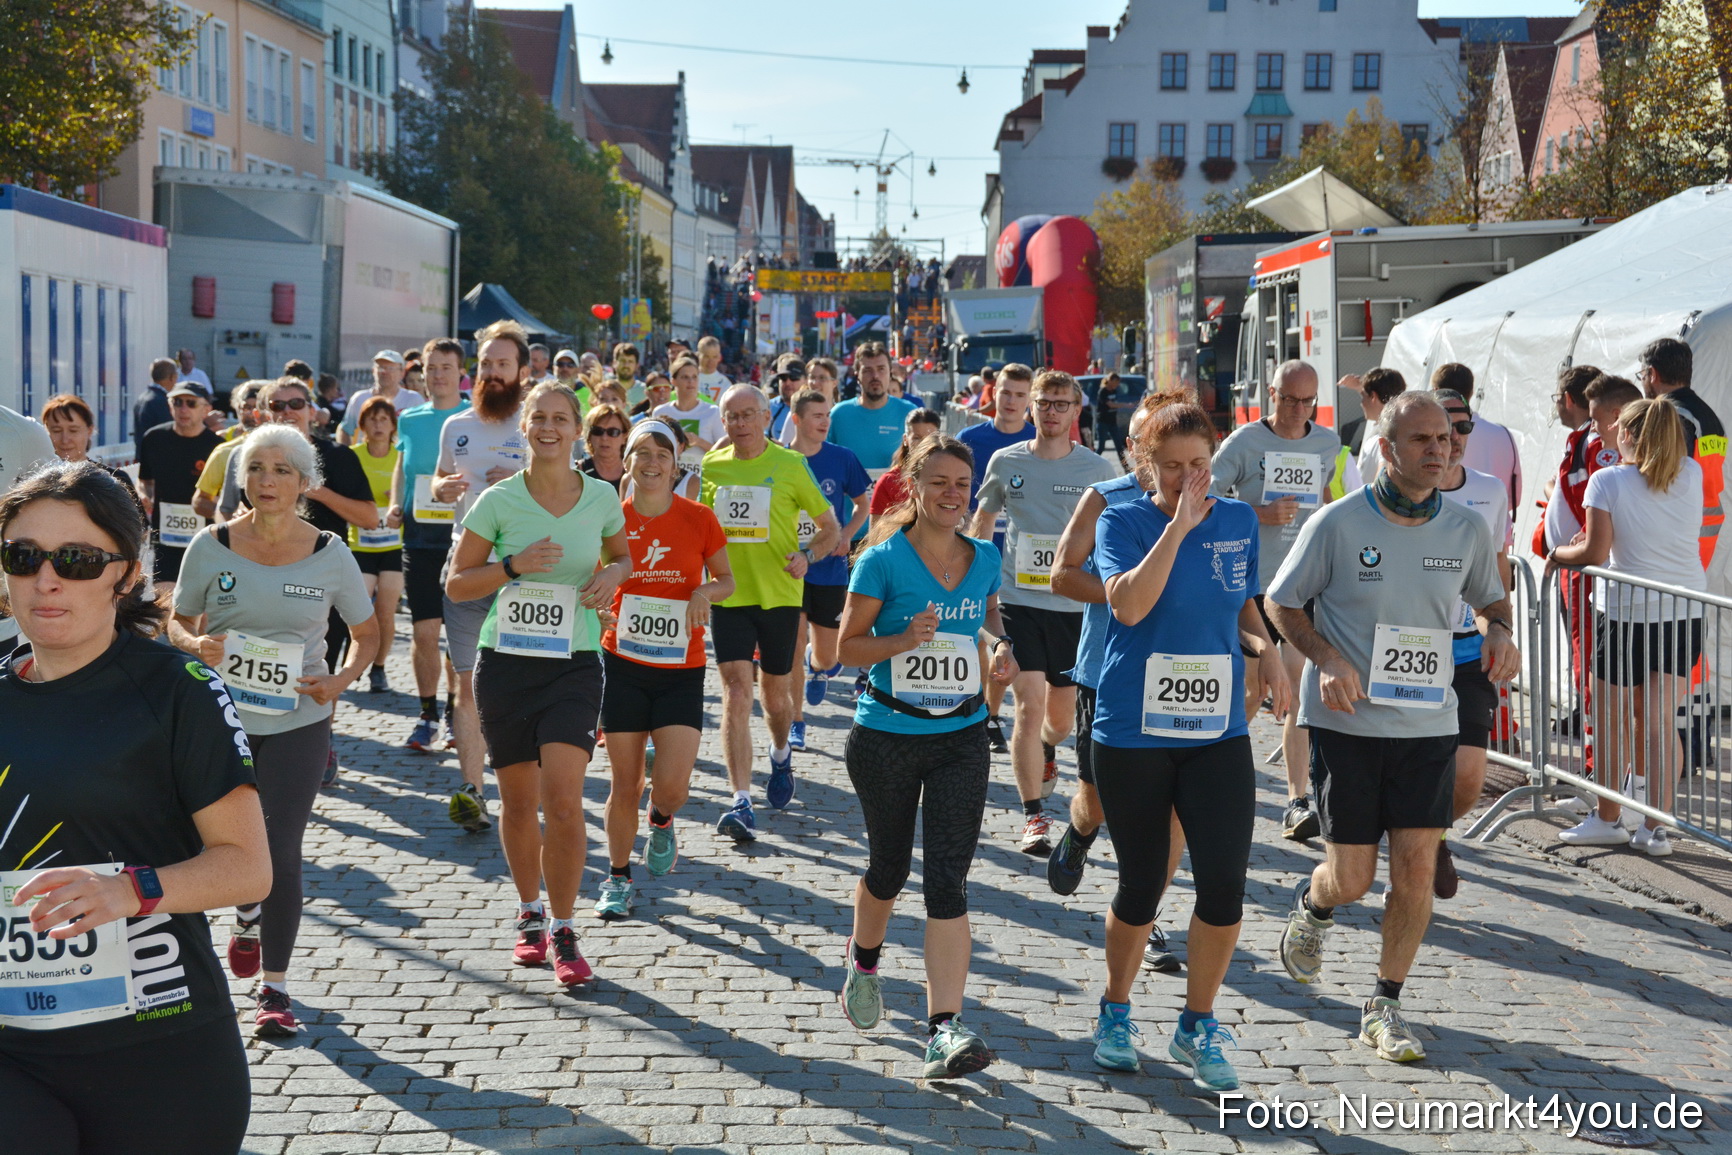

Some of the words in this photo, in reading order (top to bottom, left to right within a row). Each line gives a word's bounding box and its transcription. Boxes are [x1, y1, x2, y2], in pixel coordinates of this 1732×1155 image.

[802, 275, 848, 286] START
[1274, 468, 1313, 486] 2382
[729, 502, 750, 519] 32
[166, 515, 198, 529] 2569
[724, 528, 755, 536] Eberhard
[1423, 557, 1462, 569] BOCK
[283, 584, 324, 598] BOCK
[520, 588, 553, 598] BOCK
[508, 601, 564, 626] 3089
[640, 602, 671, 612] BOCK
[628, 614, 679, 638] 3090
[1399, 634, 1431, 644] BOCK
[244, 642, 279, 656] BOCK
[1172, 662, 1209, 671] BOCK
[1383, 648, 1438, 675] 2336
[228, 654, 288, 685] 2155
[905, 656, 968, 682] 2010
[1158, 677, 1220, 703] 2999
[1394, 687, 1424, 699] Martin
[241, 692, 267, 706] Petra
[919, 695, 954, 707] Janina
[1173, 717, 1202, 731] Birgit
[0, 970, 25, 979] ARTL
[27, 968, 76, 979] Neumarkt
[26, 991, 57, 1011] Ute
[138, 999, 146, 1007] by
[148, 990, 186, 1004] Lammsbräu
[136, 1001, 192, 1022] drinknow.de
